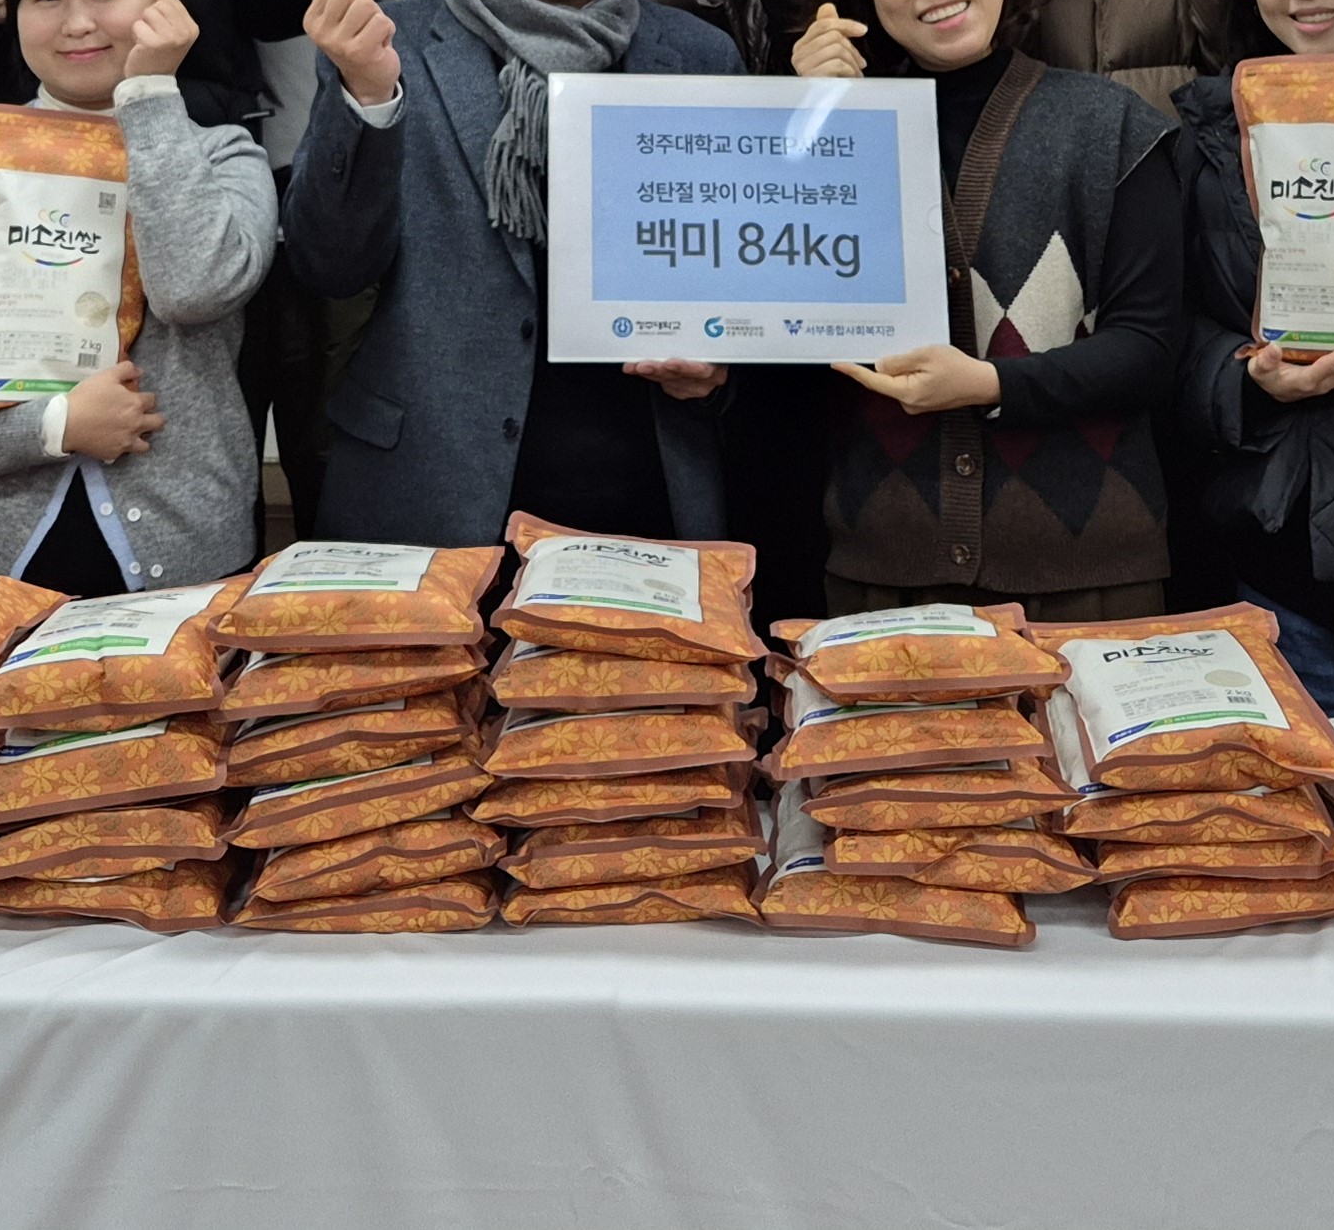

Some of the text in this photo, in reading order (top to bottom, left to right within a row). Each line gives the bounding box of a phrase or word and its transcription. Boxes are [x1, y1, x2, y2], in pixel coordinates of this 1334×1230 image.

[636, 133, 733, 156] 청주대학교
[737, 135, 798, 156] GTEP
[636, 181, 858, 206] 성탄절 맞이 이웃나눔후원
[7, 223, 102, 255] 미소진쌀
[636, 218, 861, 279] 백미 84kg
[805, 324, 895, 337] 서부종합사회복지관
[80, 338, 88, 350] 2
[89, 339, 102, 354] kg
